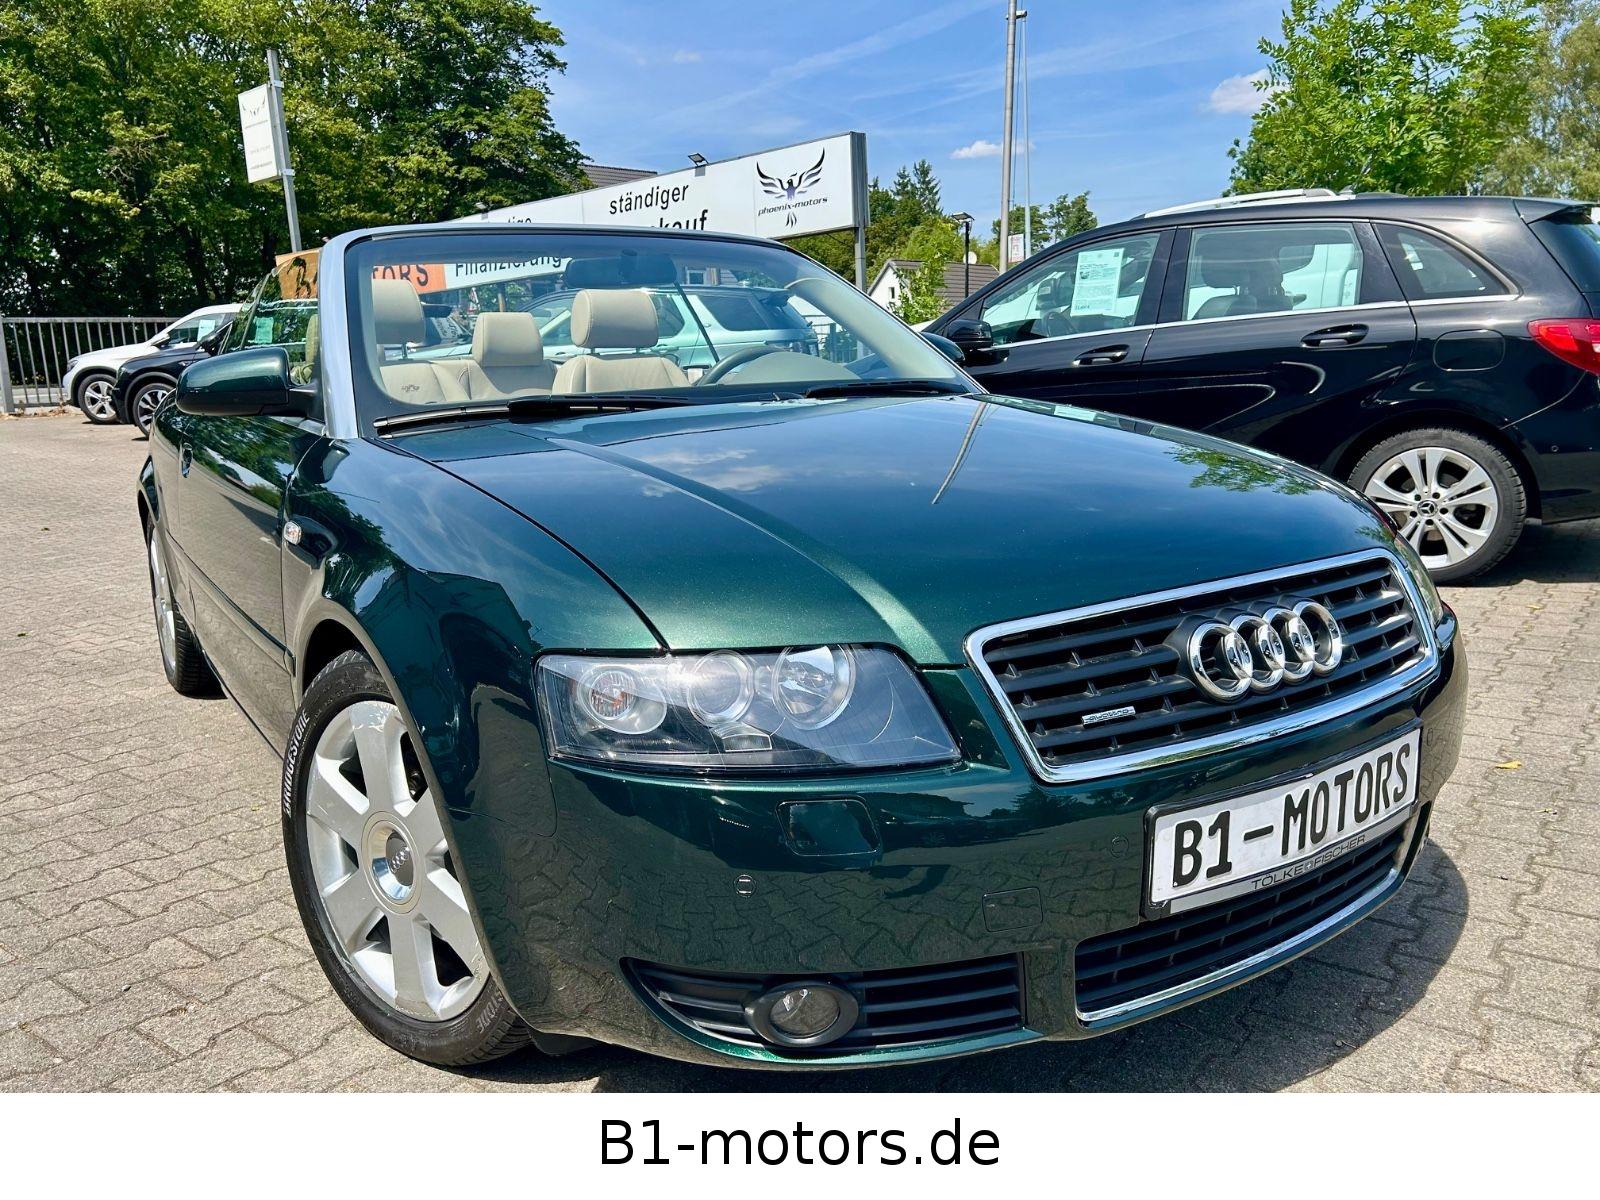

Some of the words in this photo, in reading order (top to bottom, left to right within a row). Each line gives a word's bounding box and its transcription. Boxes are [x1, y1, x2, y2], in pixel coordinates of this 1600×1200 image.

[609, 185, 689, 215] ständiger
[758, 197, 828, 217] phoenix-motors
[283, 708, 310, 819] BRIDGESTONE
[1251, 864, 1303, 890] TÖLKE
[1313, 834, 1366, 867] FISCHER
